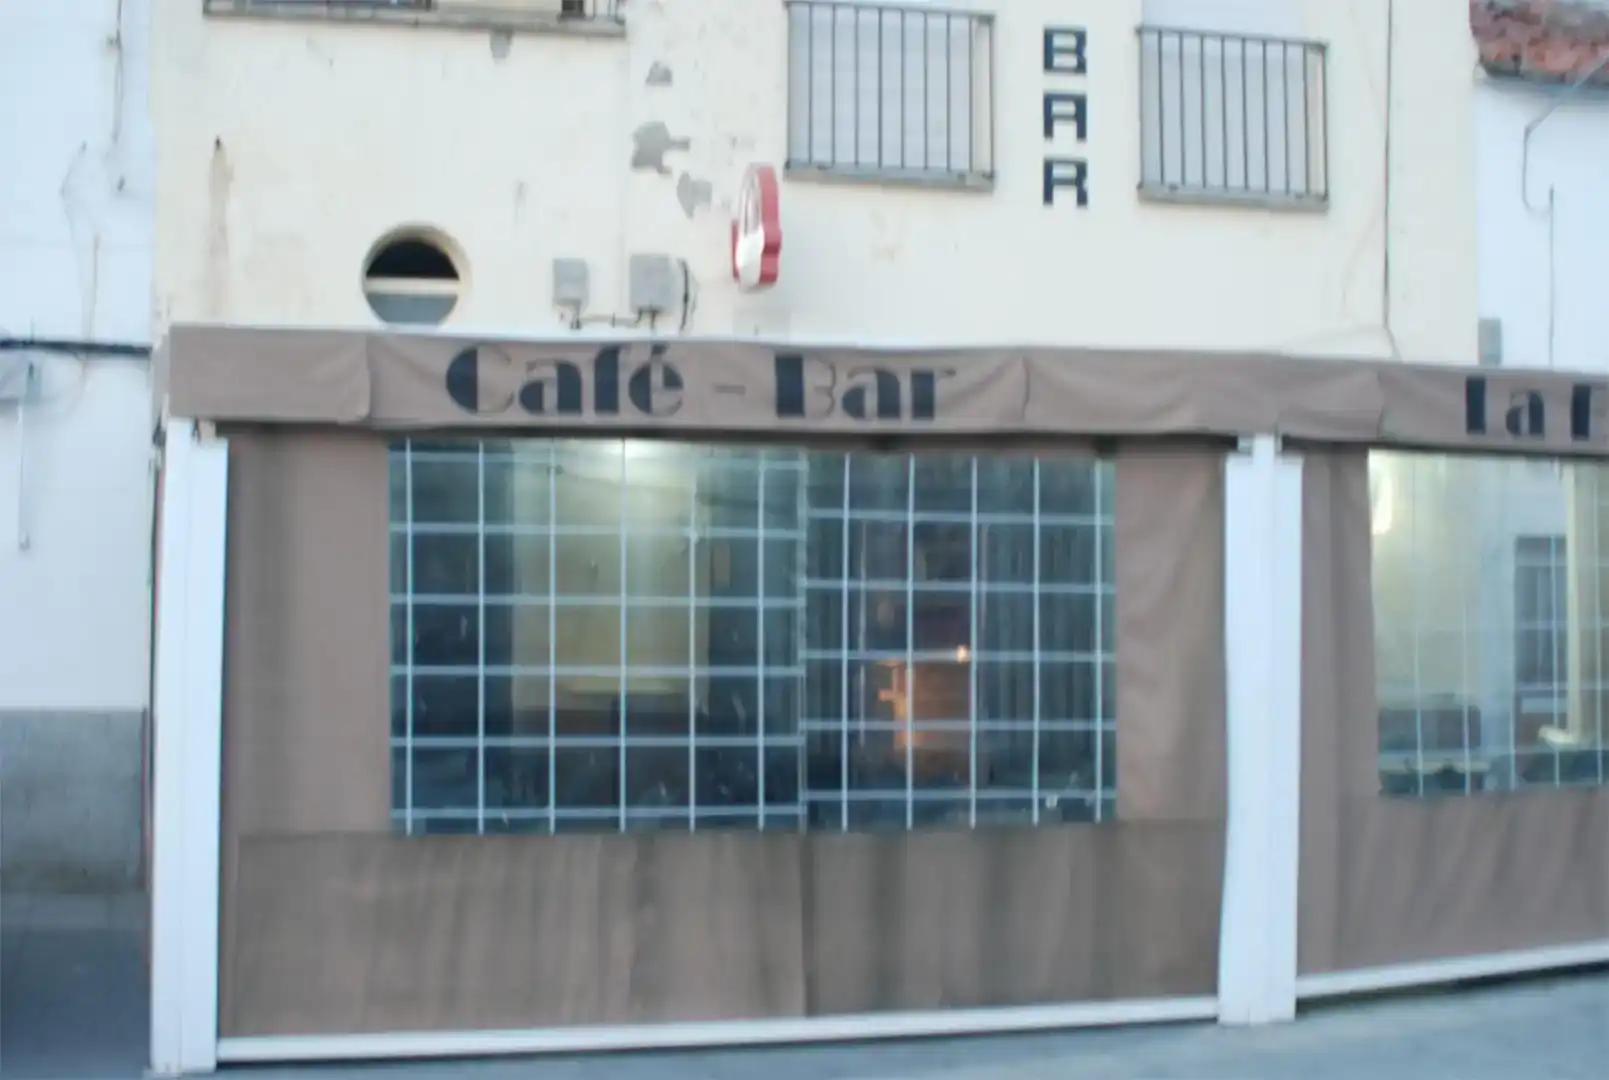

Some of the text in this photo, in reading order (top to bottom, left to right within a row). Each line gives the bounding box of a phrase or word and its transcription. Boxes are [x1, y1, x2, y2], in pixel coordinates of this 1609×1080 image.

[1043, 26, 1088, 207] BAR
[445, 341, 684, 417] Café
[774, 353, 957, 421] Bar
